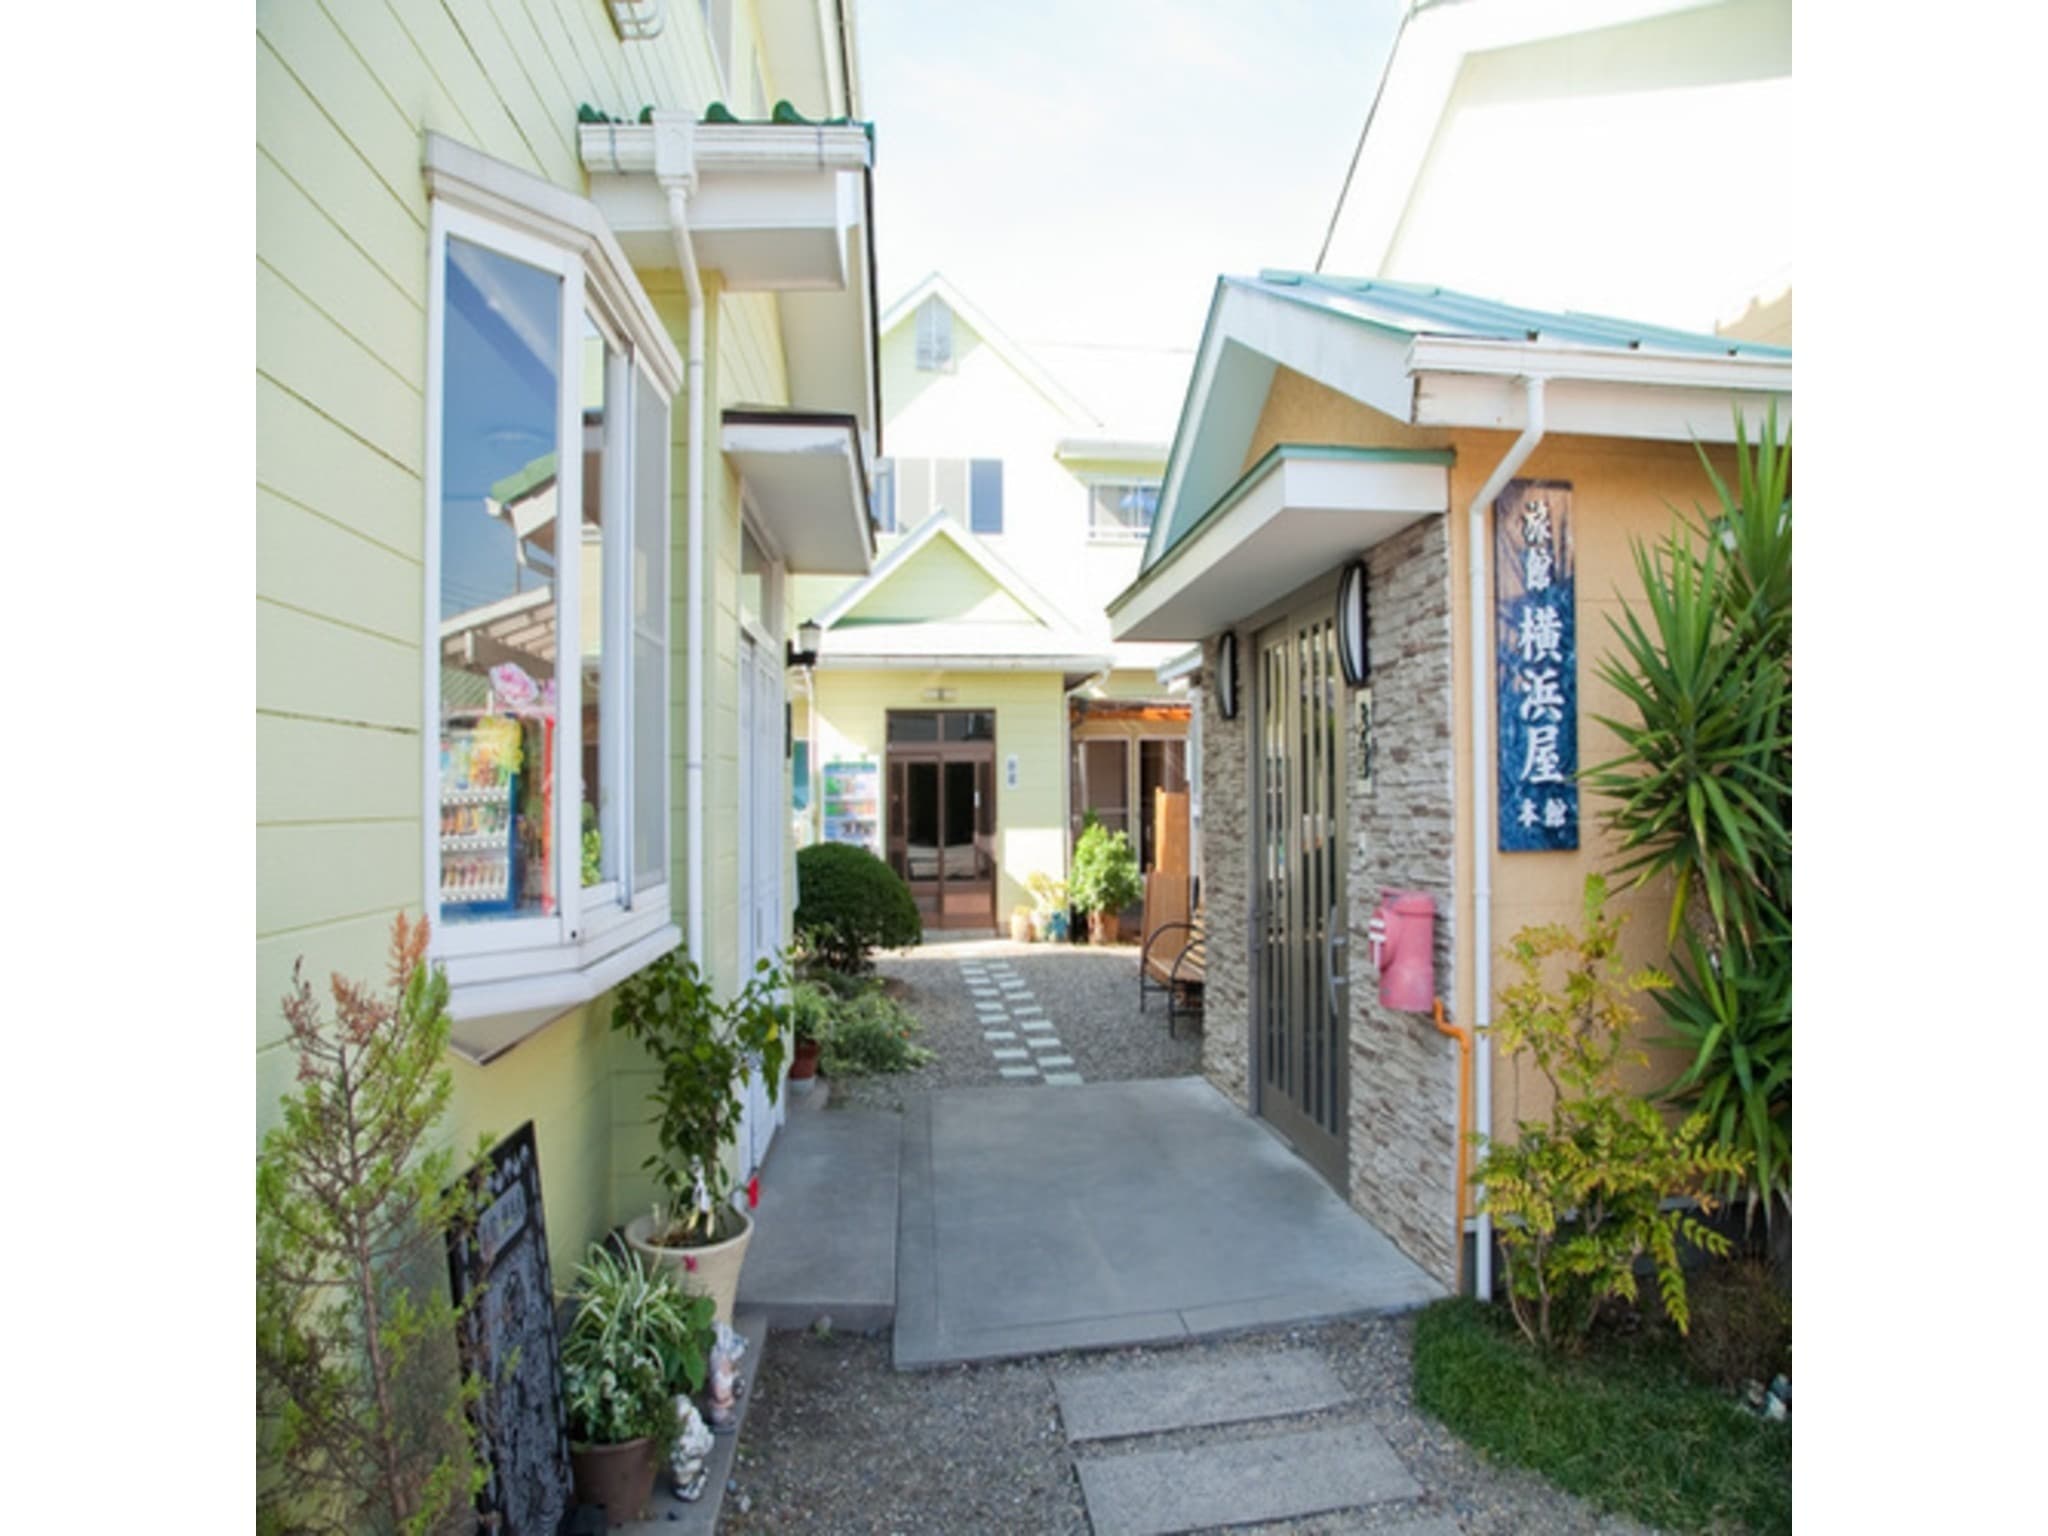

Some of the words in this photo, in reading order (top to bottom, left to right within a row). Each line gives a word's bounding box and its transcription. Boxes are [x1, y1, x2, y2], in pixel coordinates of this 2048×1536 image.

[1522, 499, 1551, 591] 旅館
[1518, 604, 1565, 783] 横浜屋
[1517, 797, 1568, 828] 本館
